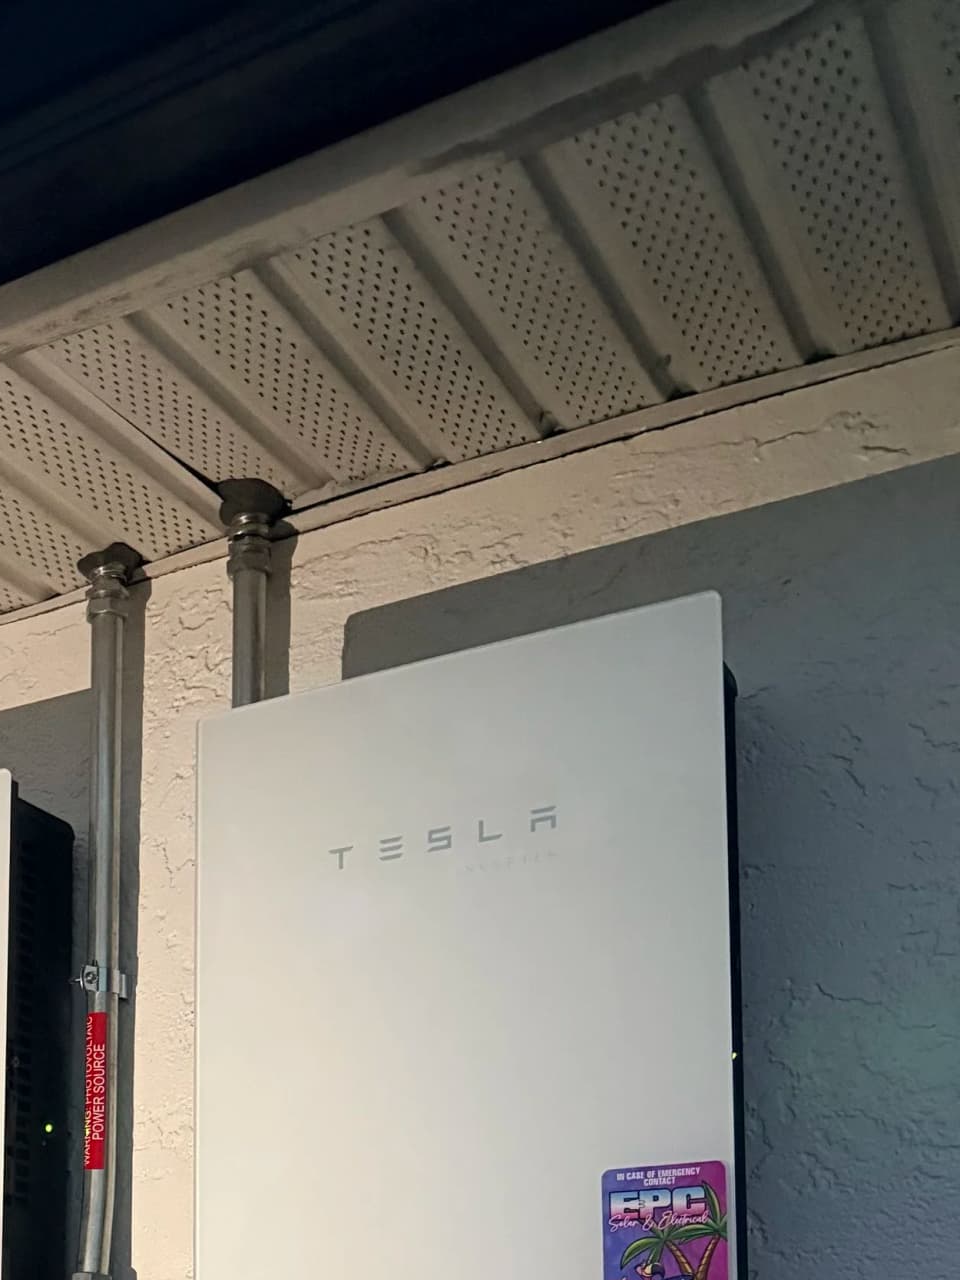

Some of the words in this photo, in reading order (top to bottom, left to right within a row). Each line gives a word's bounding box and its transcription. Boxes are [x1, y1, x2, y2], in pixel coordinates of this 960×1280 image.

[328, 806, 557, 870] TESLA
[92, 1044, 106, 1094] SOURCE
[92, 1096, 105, 1141] POWER
[626, 1172, 644, 1180] CASE
[646, 1170, 656, 1178] OF
[658, 1167, 701, 1177] EMERGENCY
[644, 1177, 676, 1186] CONTACT
[609, 1186, 706, 1220] EPC
[608, 1215, 640, 1232] Solar
